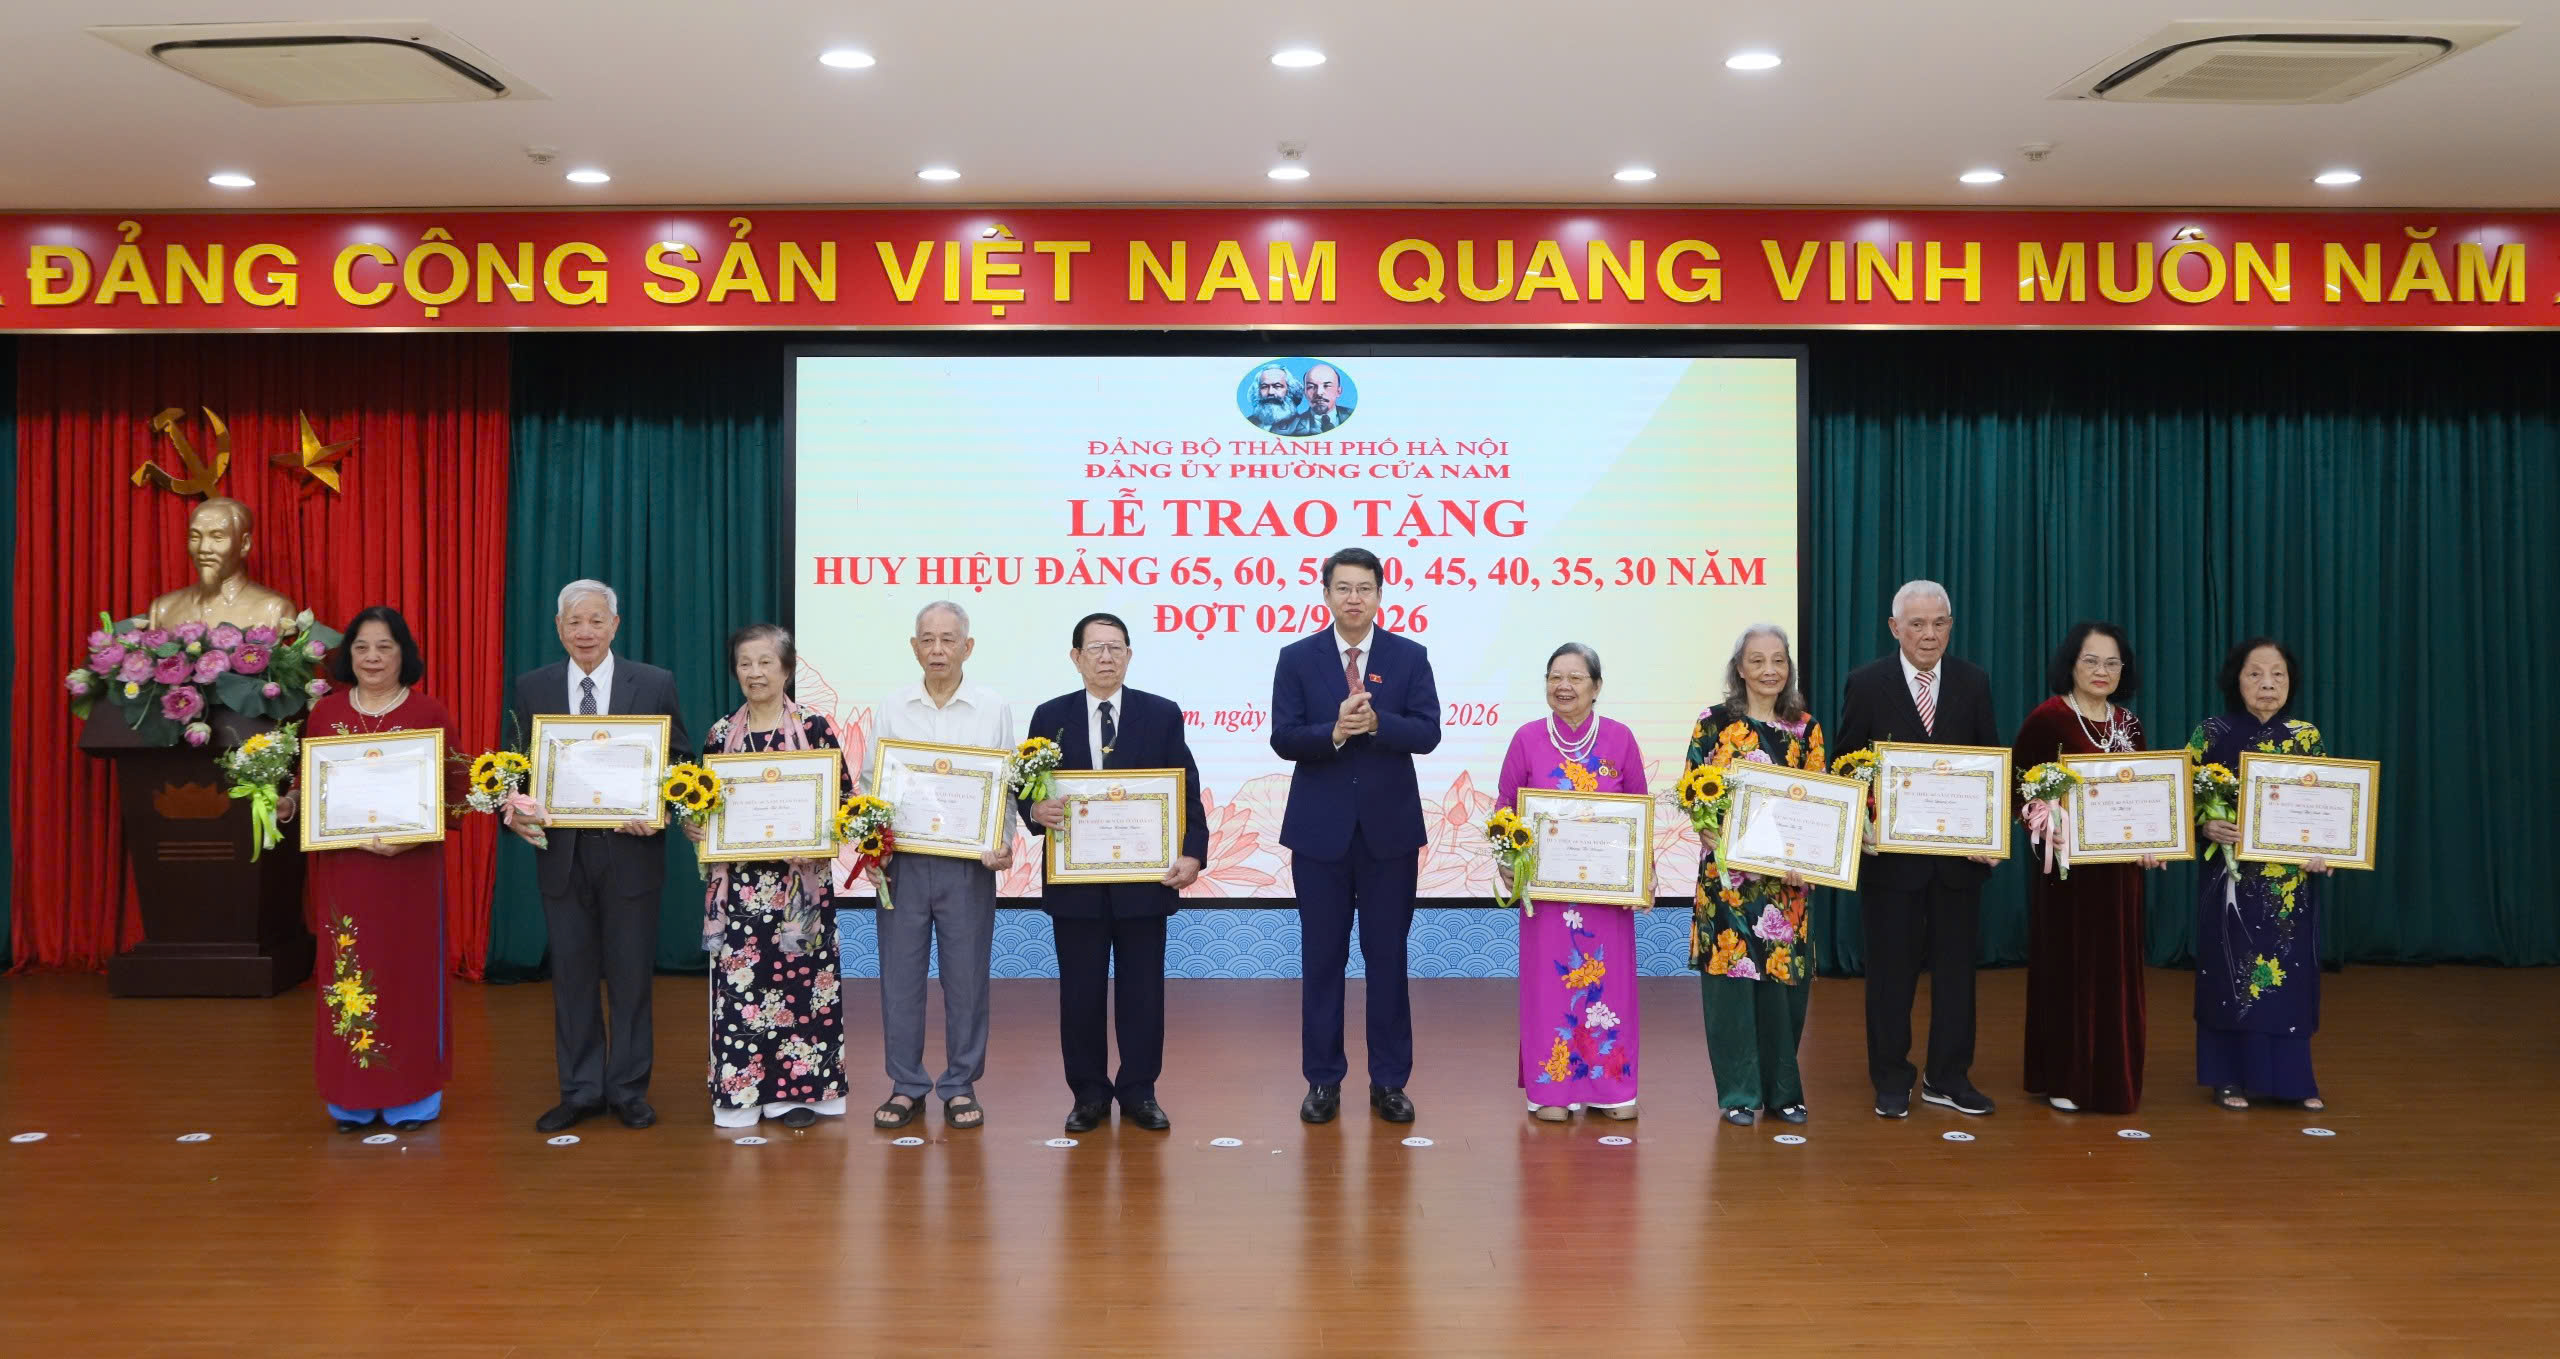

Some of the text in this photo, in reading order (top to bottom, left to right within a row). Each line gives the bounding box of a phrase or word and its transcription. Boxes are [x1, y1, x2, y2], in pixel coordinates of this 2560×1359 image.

[26, 217, 2526, 318] ĐẢNG CỘNG SẢN VIỆT NAM QUANG VINH MUÔN NĂM
[1088, 437, 1509, 459] ĐẢNG BỘ THÀNH PHỐ HÀ NỘI
[1085, 460, 1510, 479] ĐẢNG ỦY PHƯỜNG CỬA NAM
[1067, 488, 1528, 548] LỄ TRAO TẶNG
[814, 556, 907, 586] HUY
[916, 552, 1024, 592] HIỆU
[1035, 547, 1160, 586] ĐẢNG
[1170, 556, 1224, 591] 65,
[1234, 556, 1287, 591] 60,
[1380, 556, 1414, 591] 0,
[1424, 556, 1477, 591] 45,
[1488, 556, 1541, 591] 40,
[1551, 556, 1605, 591] 35,
[1615, 556, 1657, 586] 30
[1667, 549, 1767, 586] NĂM
[1154, 602, 1246, 641] ĐỢT
[1213, 703, 1267, 732] ngày
[1445, 703, 1499, 726] 2026
